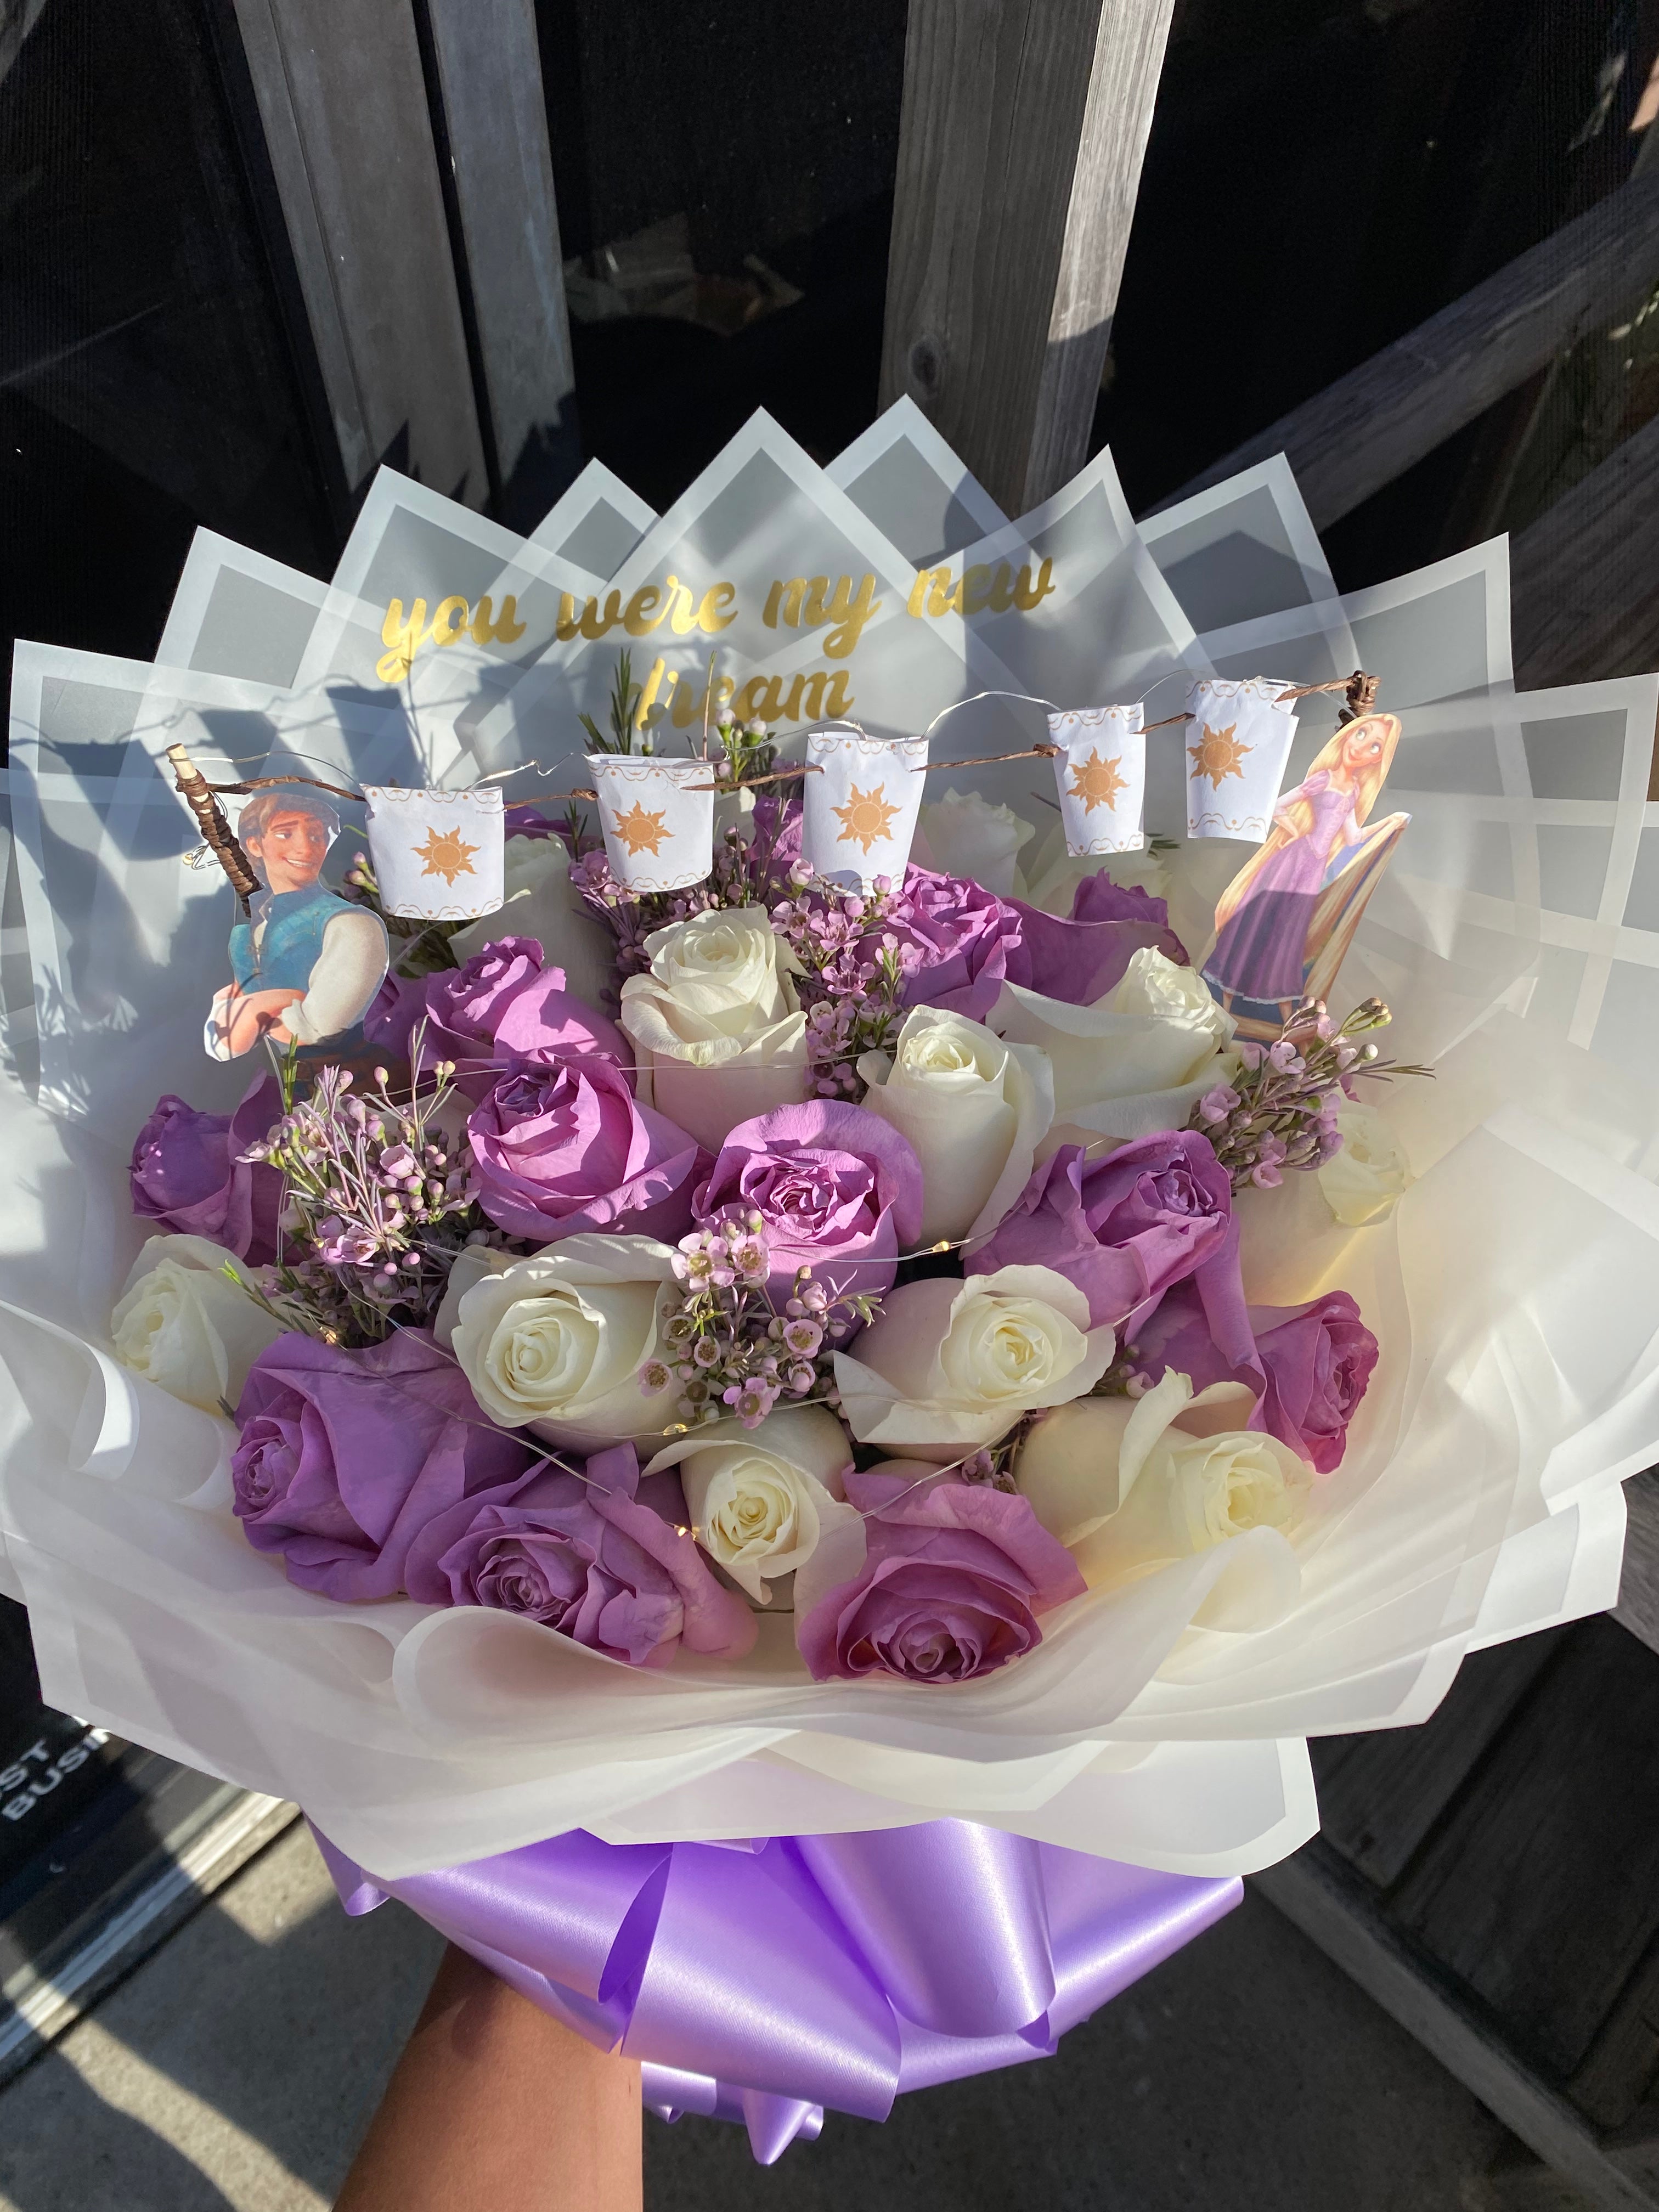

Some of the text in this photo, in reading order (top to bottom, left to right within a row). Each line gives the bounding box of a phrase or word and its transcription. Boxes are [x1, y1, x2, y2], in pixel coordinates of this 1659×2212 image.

[376, 556, 1057, 683] you were my new
[0, 1738, 49, 1799] ST
